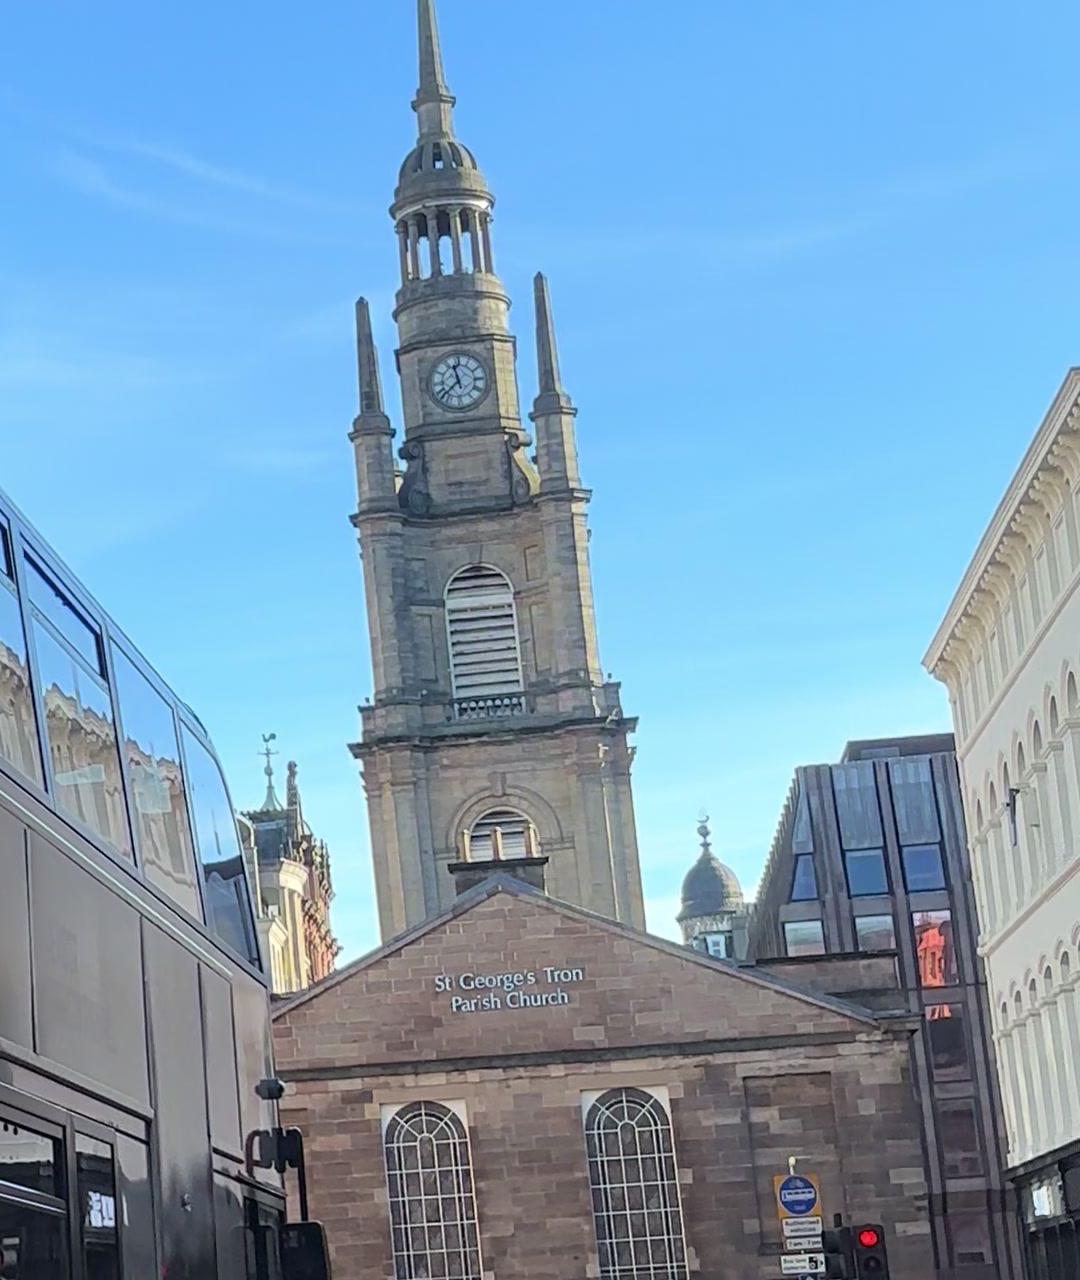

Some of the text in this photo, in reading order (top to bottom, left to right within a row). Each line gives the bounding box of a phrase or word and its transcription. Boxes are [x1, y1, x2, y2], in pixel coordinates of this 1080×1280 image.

[434, 967, 583, 992] St George's Tron
[451, 988, 568, 1012] Parish Church
